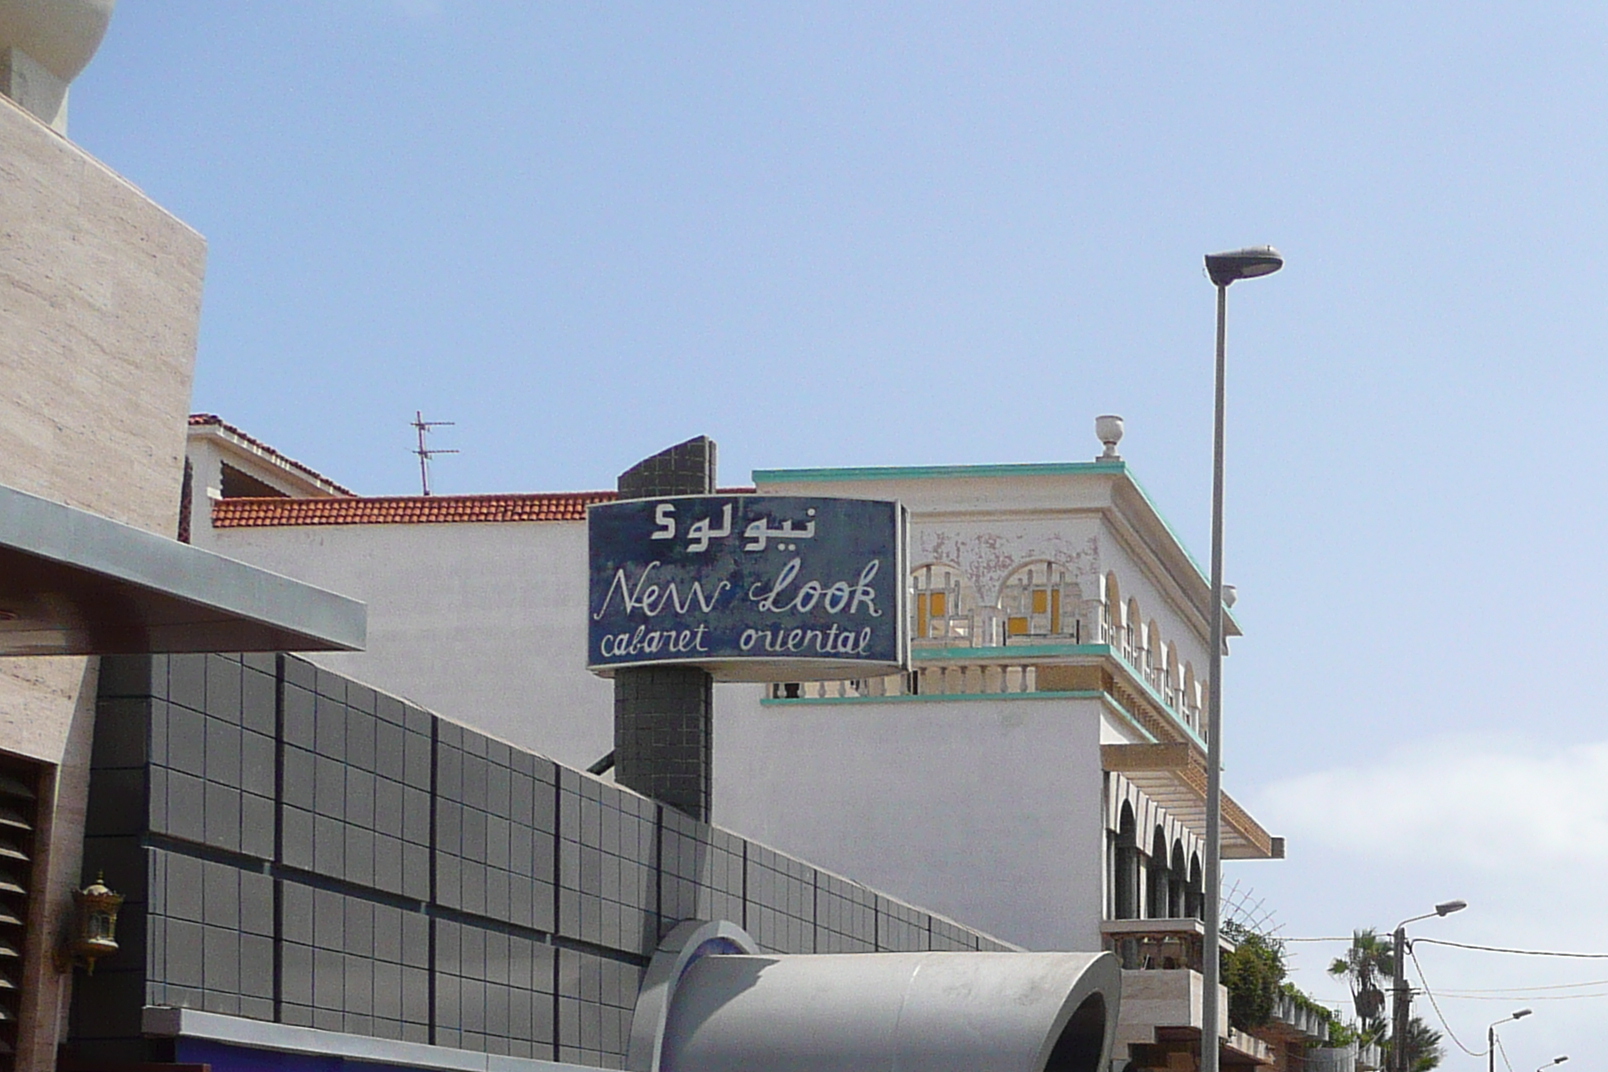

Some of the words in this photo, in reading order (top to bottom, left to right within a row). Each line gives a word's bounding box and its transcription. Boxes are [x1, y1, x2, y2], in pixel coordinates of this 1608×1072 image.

[593, 561, 731, 621] New
[600, 624, 709, 658] cabaret
[739, 622, 873, 656] oriental
